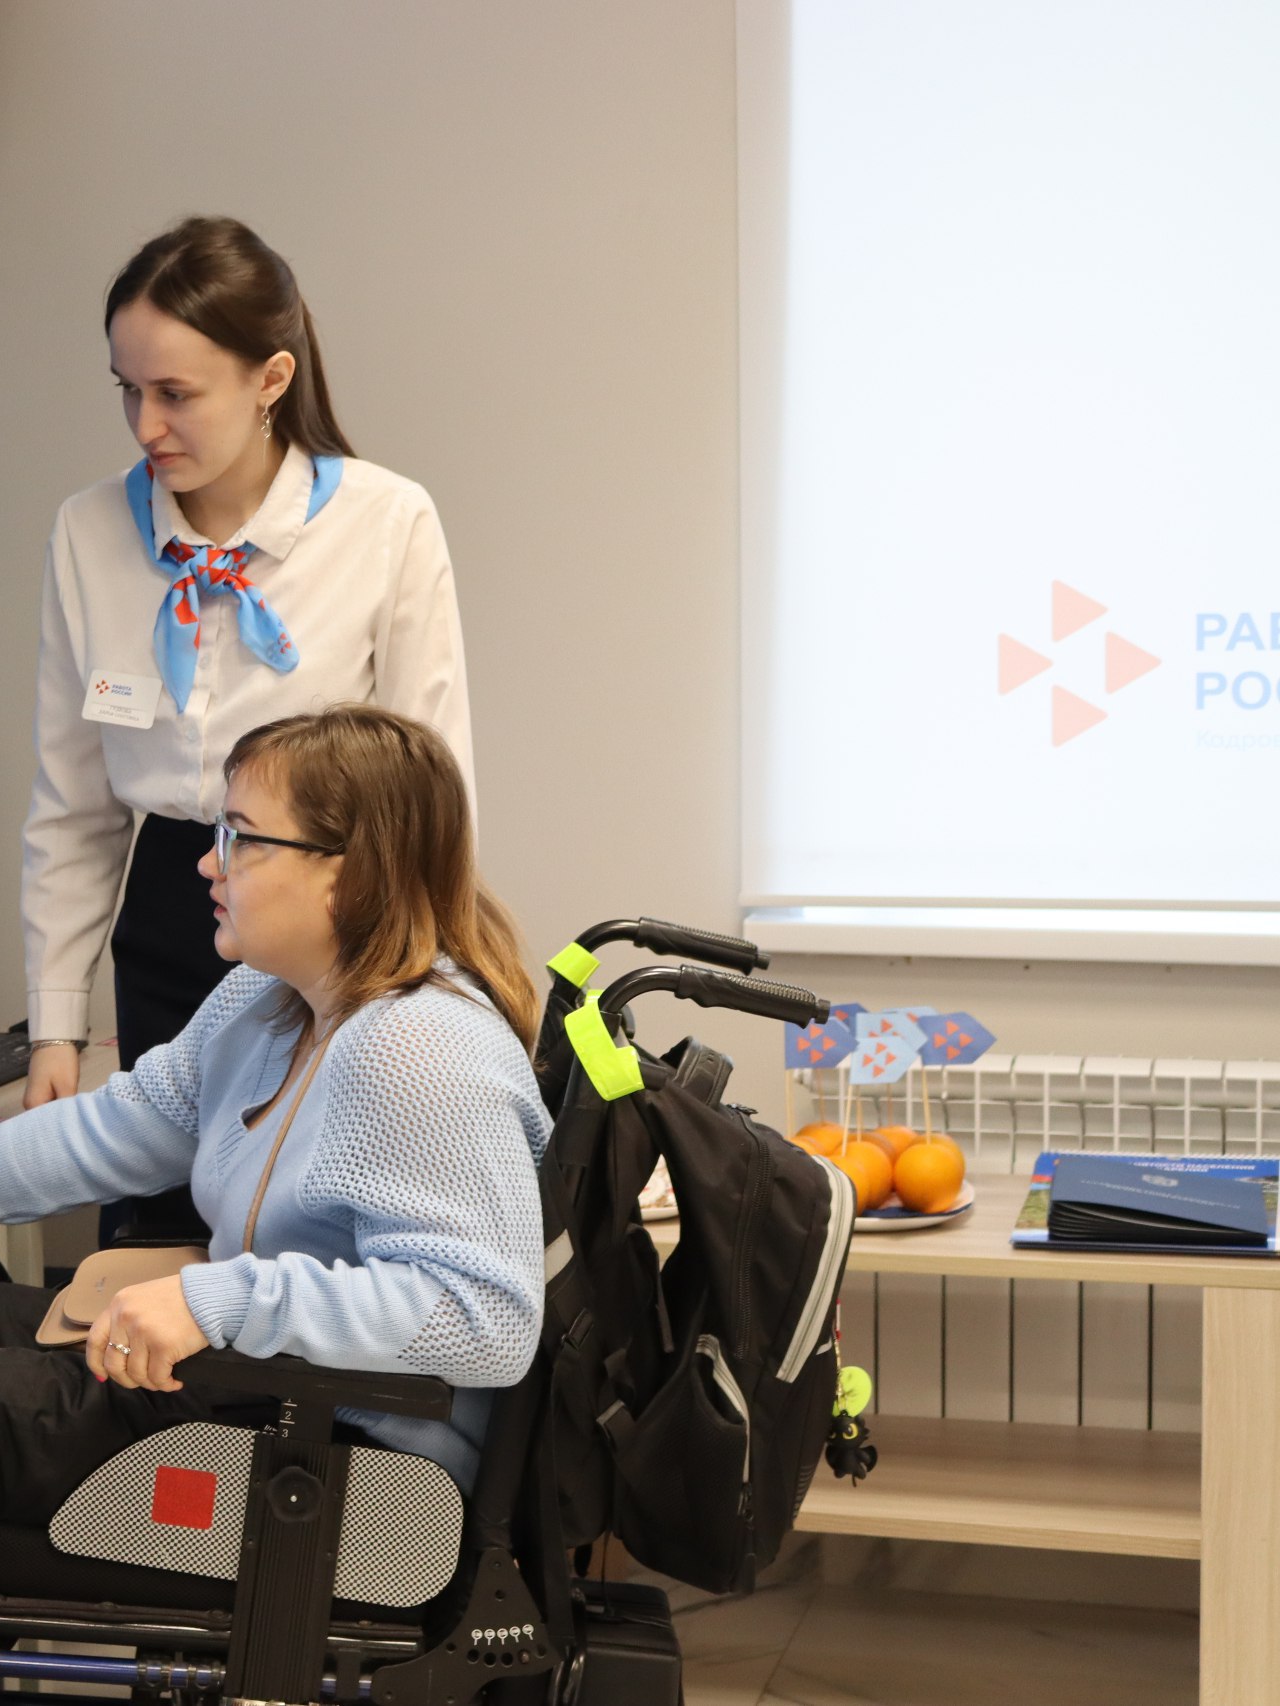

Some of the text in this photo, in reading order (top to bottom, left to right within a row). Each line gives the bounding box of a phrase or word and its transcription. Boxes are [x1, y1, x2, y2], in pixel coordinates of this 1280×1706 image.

[1195, 671, 1280, 710] РО
[284, 1411, 292, 1420] 2
[281, 1428, 289, 1438] 3
